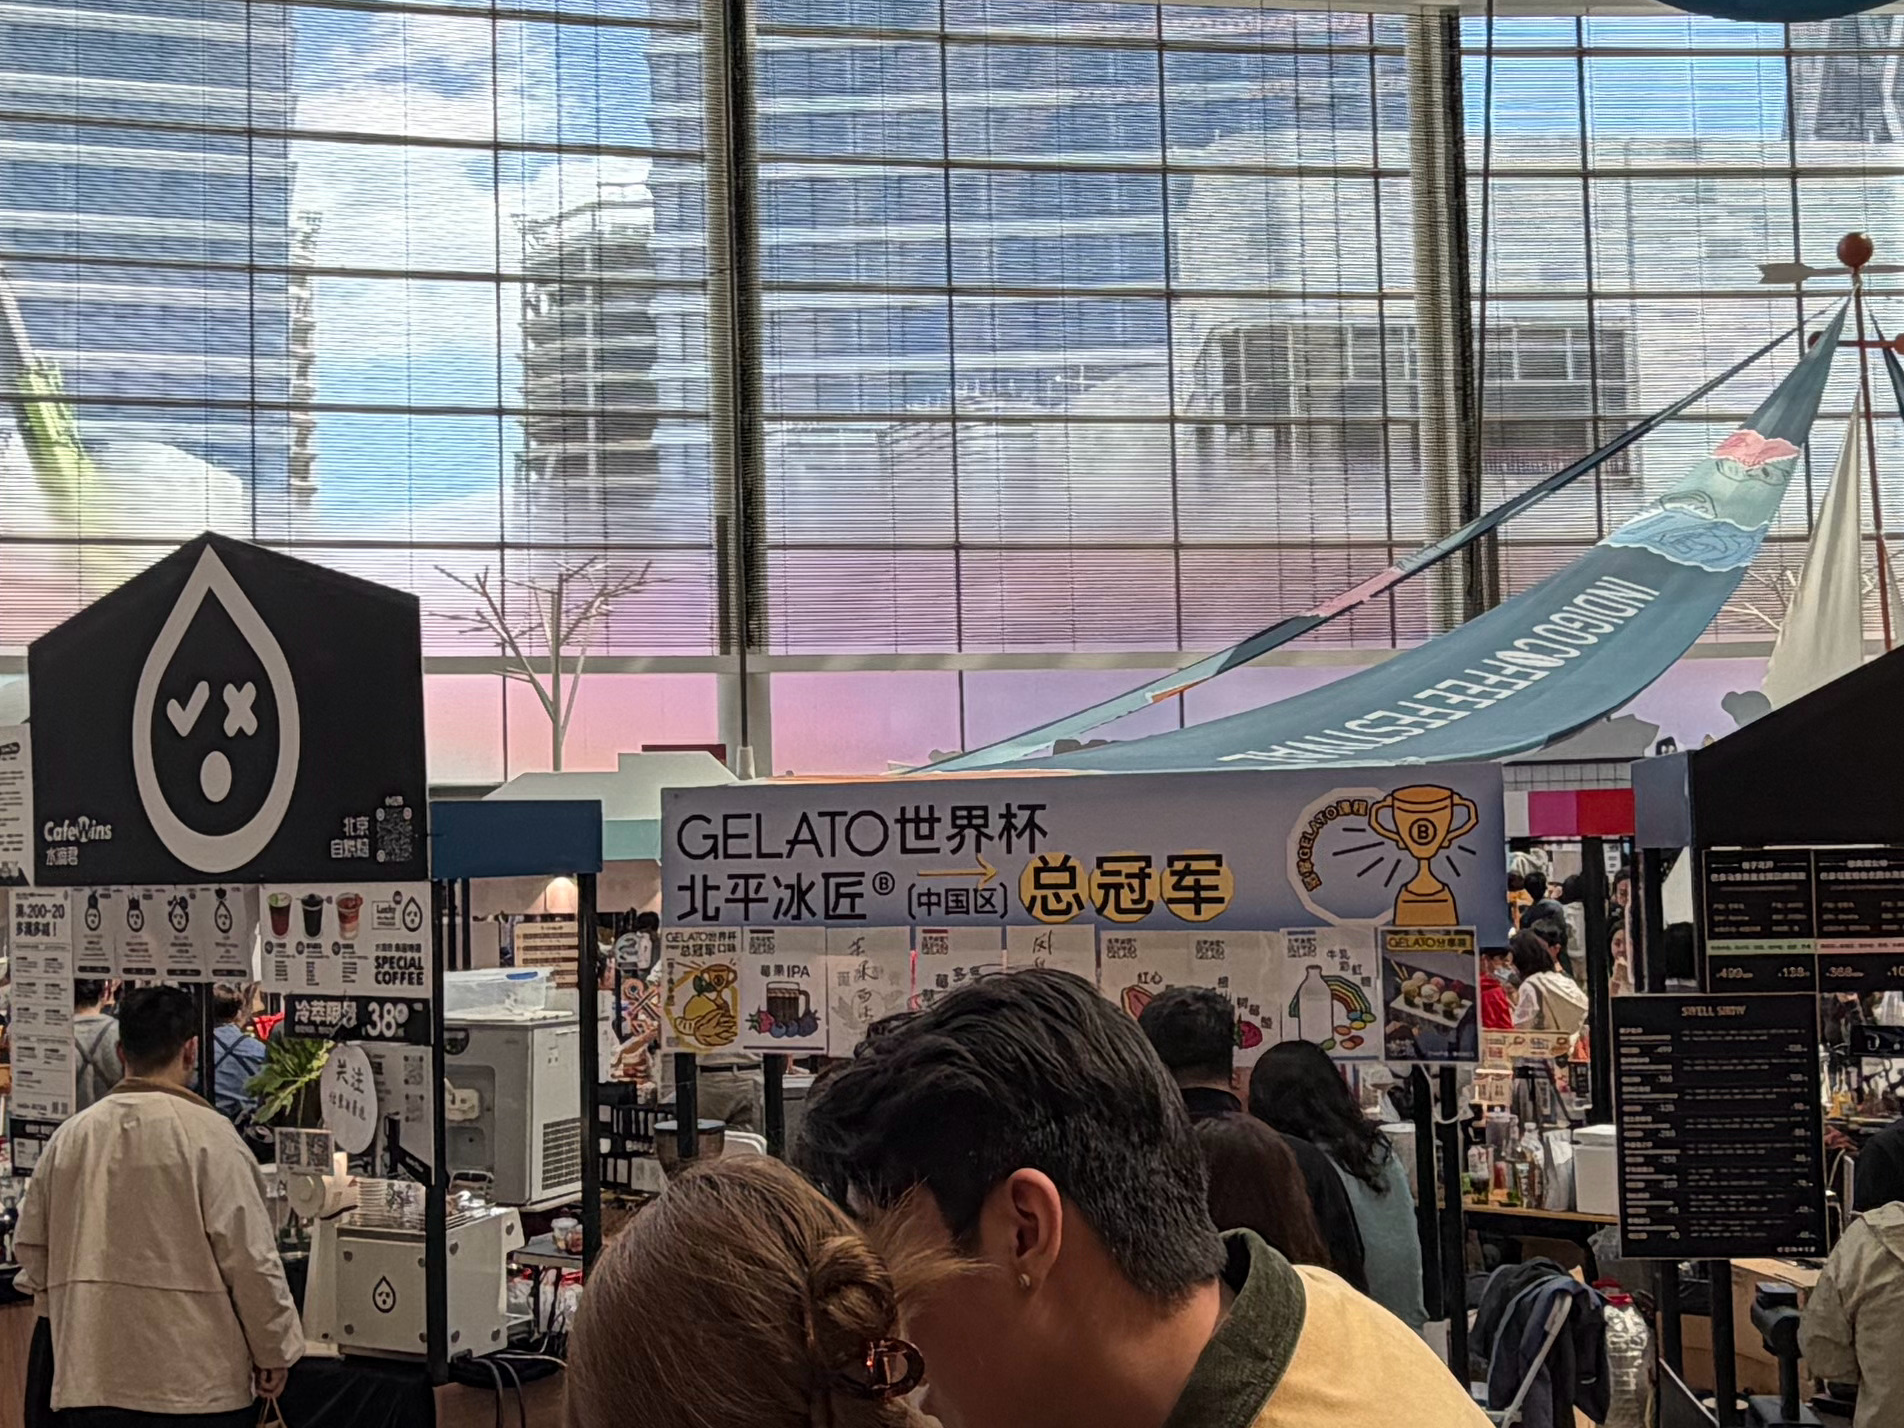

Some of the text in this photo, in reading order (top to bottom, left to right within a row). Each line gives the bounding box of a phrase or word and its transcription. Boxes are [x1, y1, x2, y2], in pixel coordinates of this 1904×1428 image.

[1532, 576, 1660, 656] INDIGO
[676, 802, 1048, 860] GELATO世界杯
[1025, 854, 1226, 917] 总冠军
[375, 955, 424, 970] SPECIAL
[375, 971, 424, 986] COFFEE
[1681, 1006, 1715, 1017] SWELL
